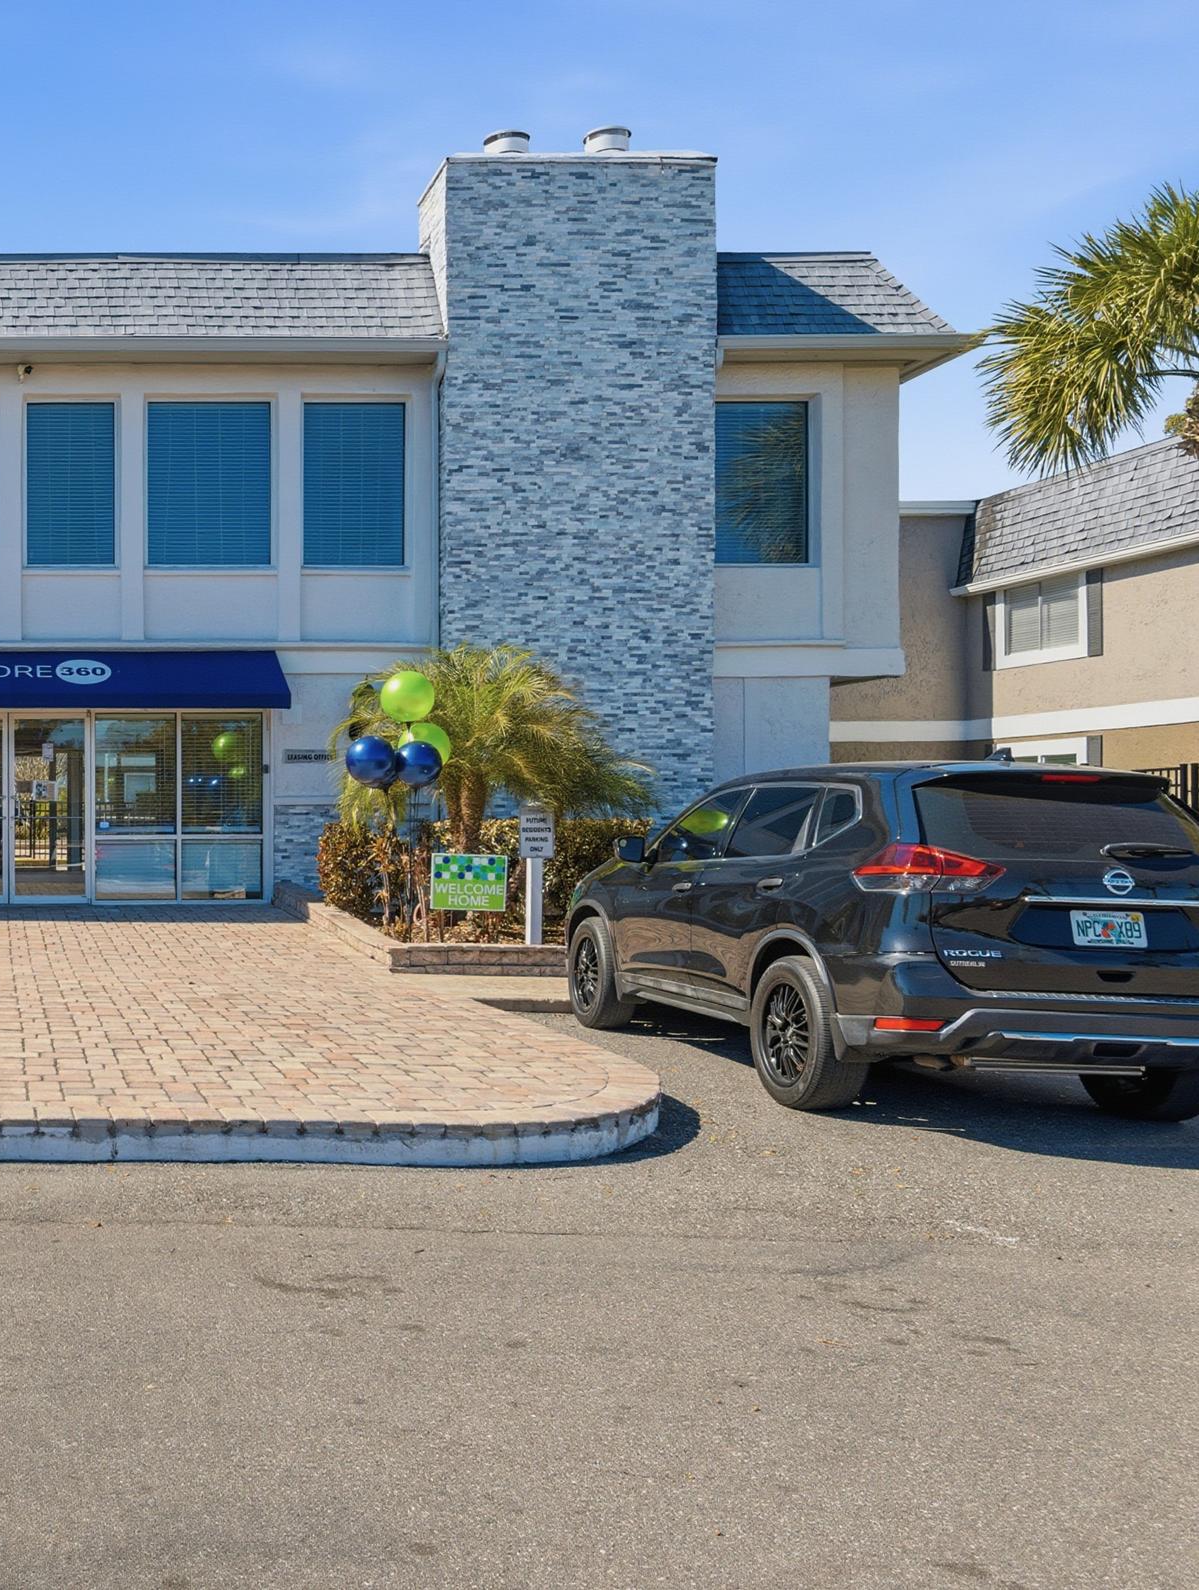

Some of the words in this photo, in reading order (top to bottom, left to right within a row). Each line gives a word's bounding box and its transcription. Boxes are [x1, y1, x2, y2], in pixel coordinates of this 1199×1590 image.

[60, 666, 106, 677] 360
[287, 753, 312, 761] LEASING
[434, 882, 505, 896] WELCOME
[448, 894, 490, 907] HOME
[943, 949, 1002, 958] ROGUE
